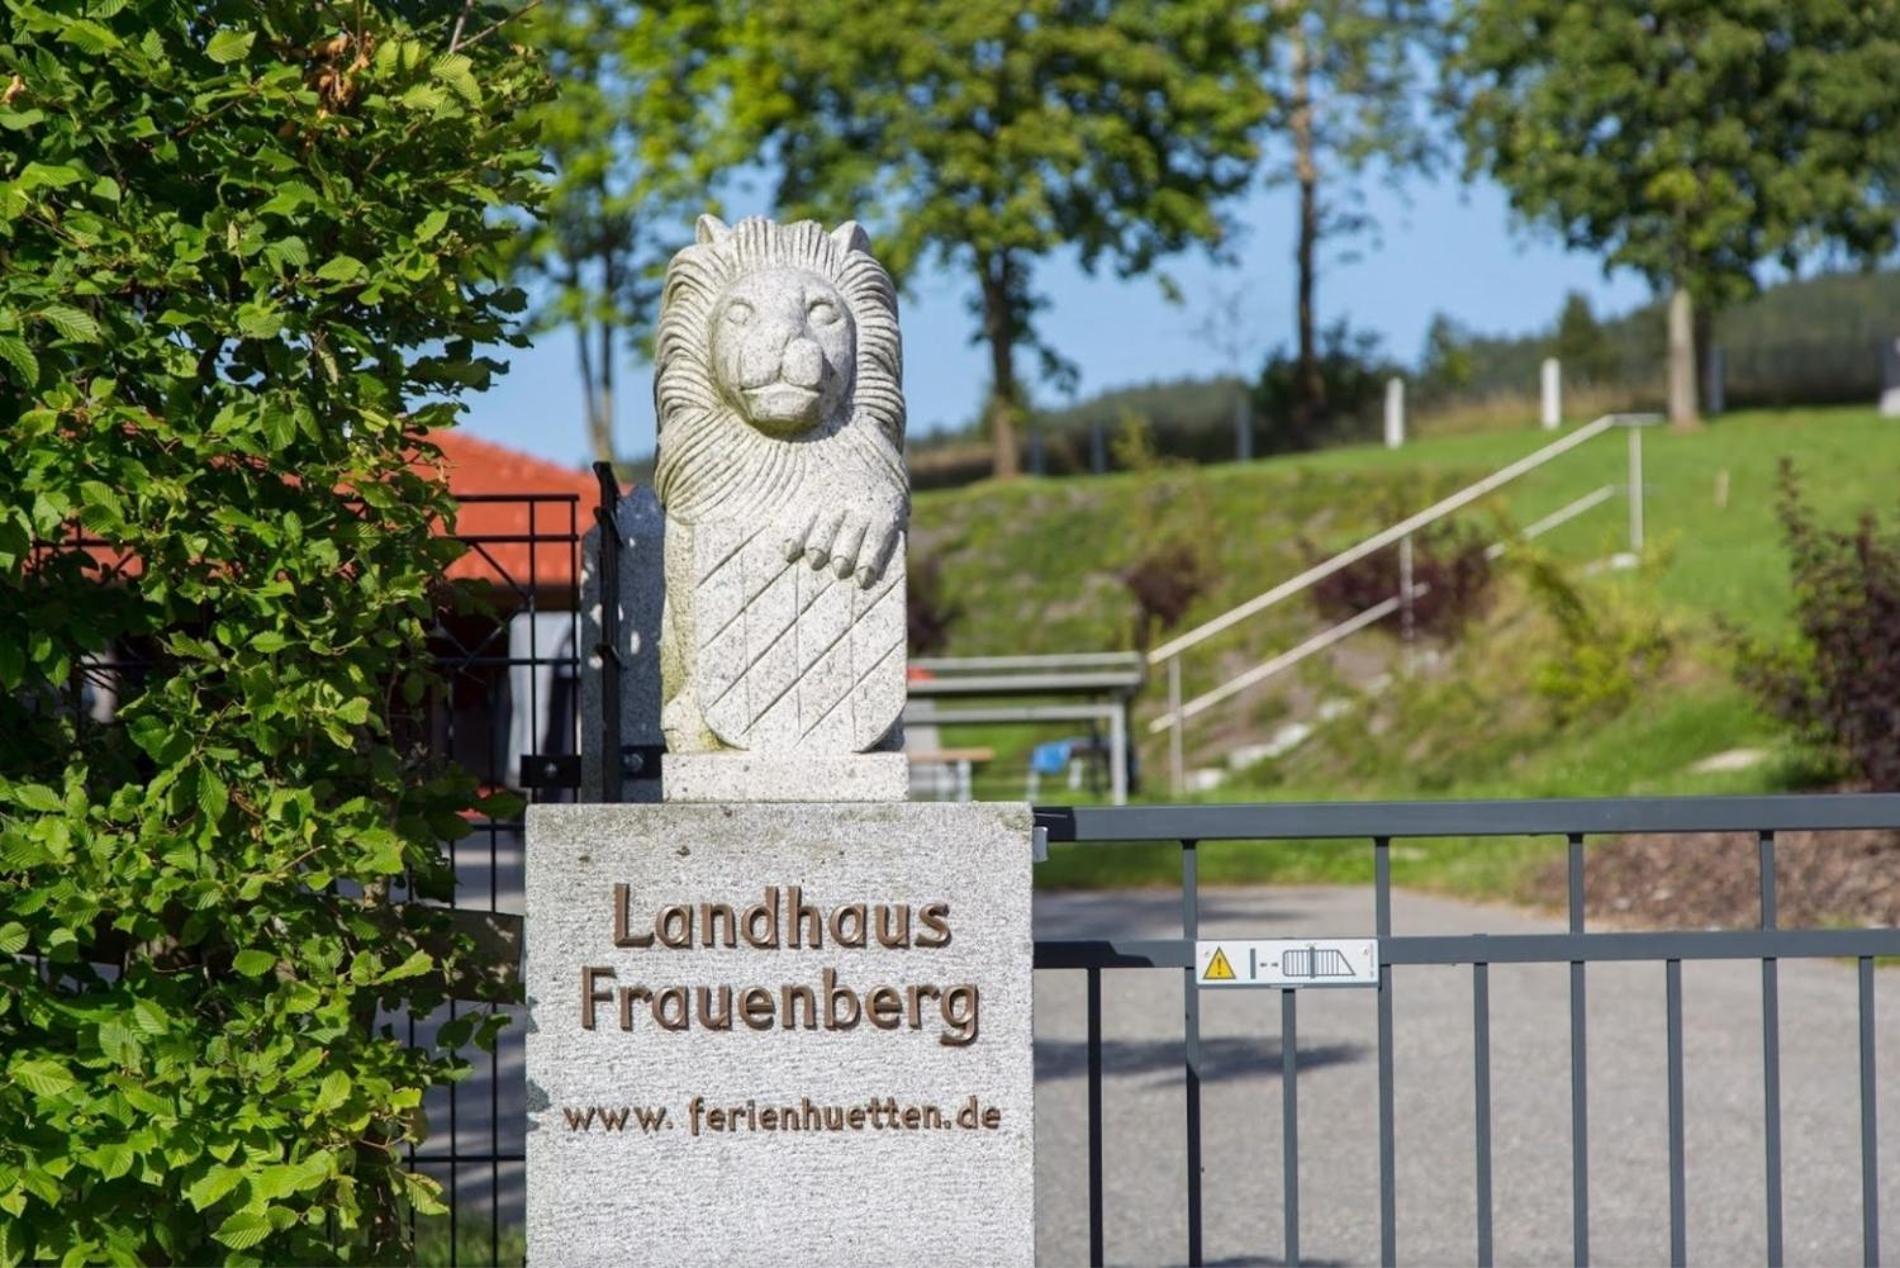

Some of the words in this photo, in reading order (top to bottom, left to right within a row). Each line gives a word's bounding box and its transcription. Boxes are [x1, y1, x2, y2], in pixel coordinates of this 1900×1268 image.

[613, 883, 951, 948] Landhaus
[581, 965, 980, 1046] Frauenberg
[688, 1095, 1002, 1136] ferienhuetten.de
